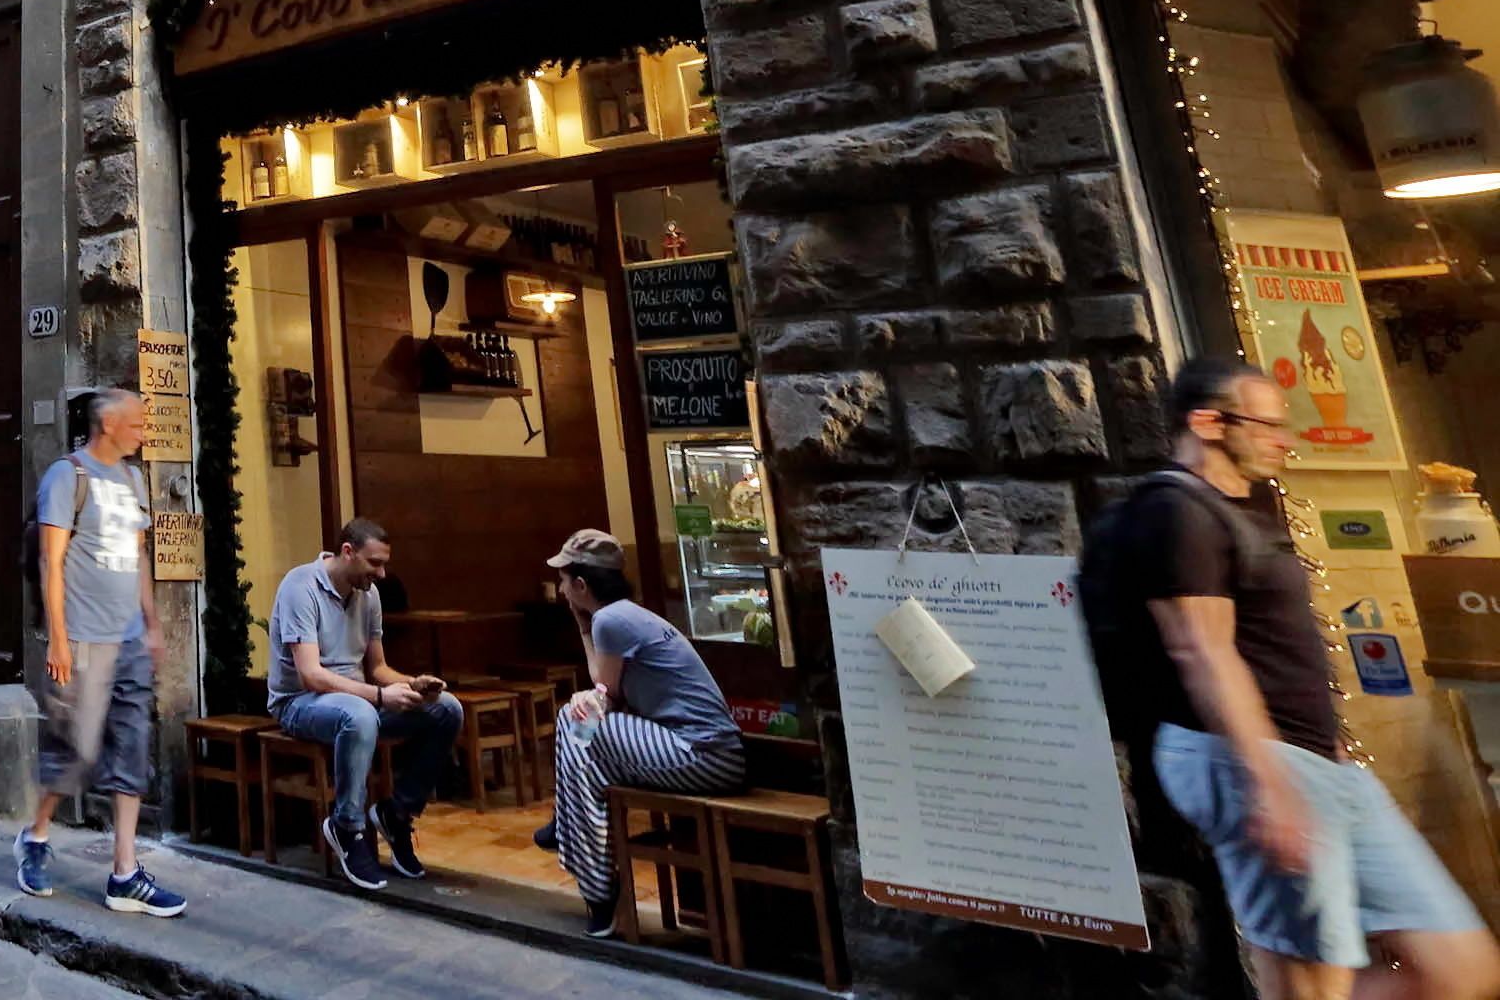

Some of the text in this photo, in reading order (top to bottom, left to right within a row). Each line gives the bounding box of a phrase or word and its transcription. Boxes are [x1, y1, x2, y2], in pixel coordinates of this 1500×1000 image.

[1255, 277, 1345, 305] ICE CREAM
[32, 309, 54, 333] 29
[692, 309, 722, 326] VINO
[648, 354, 738, 383] PROSCIUTTO
[652, 395, 722, 416] MELONE
[952, 576, 1002, 597] ghiotti
[1020, 906, 1059, 923] TUTTE
[1060, 914, 1070, 926] A
[1084, 918, 1114, 932] Euro
